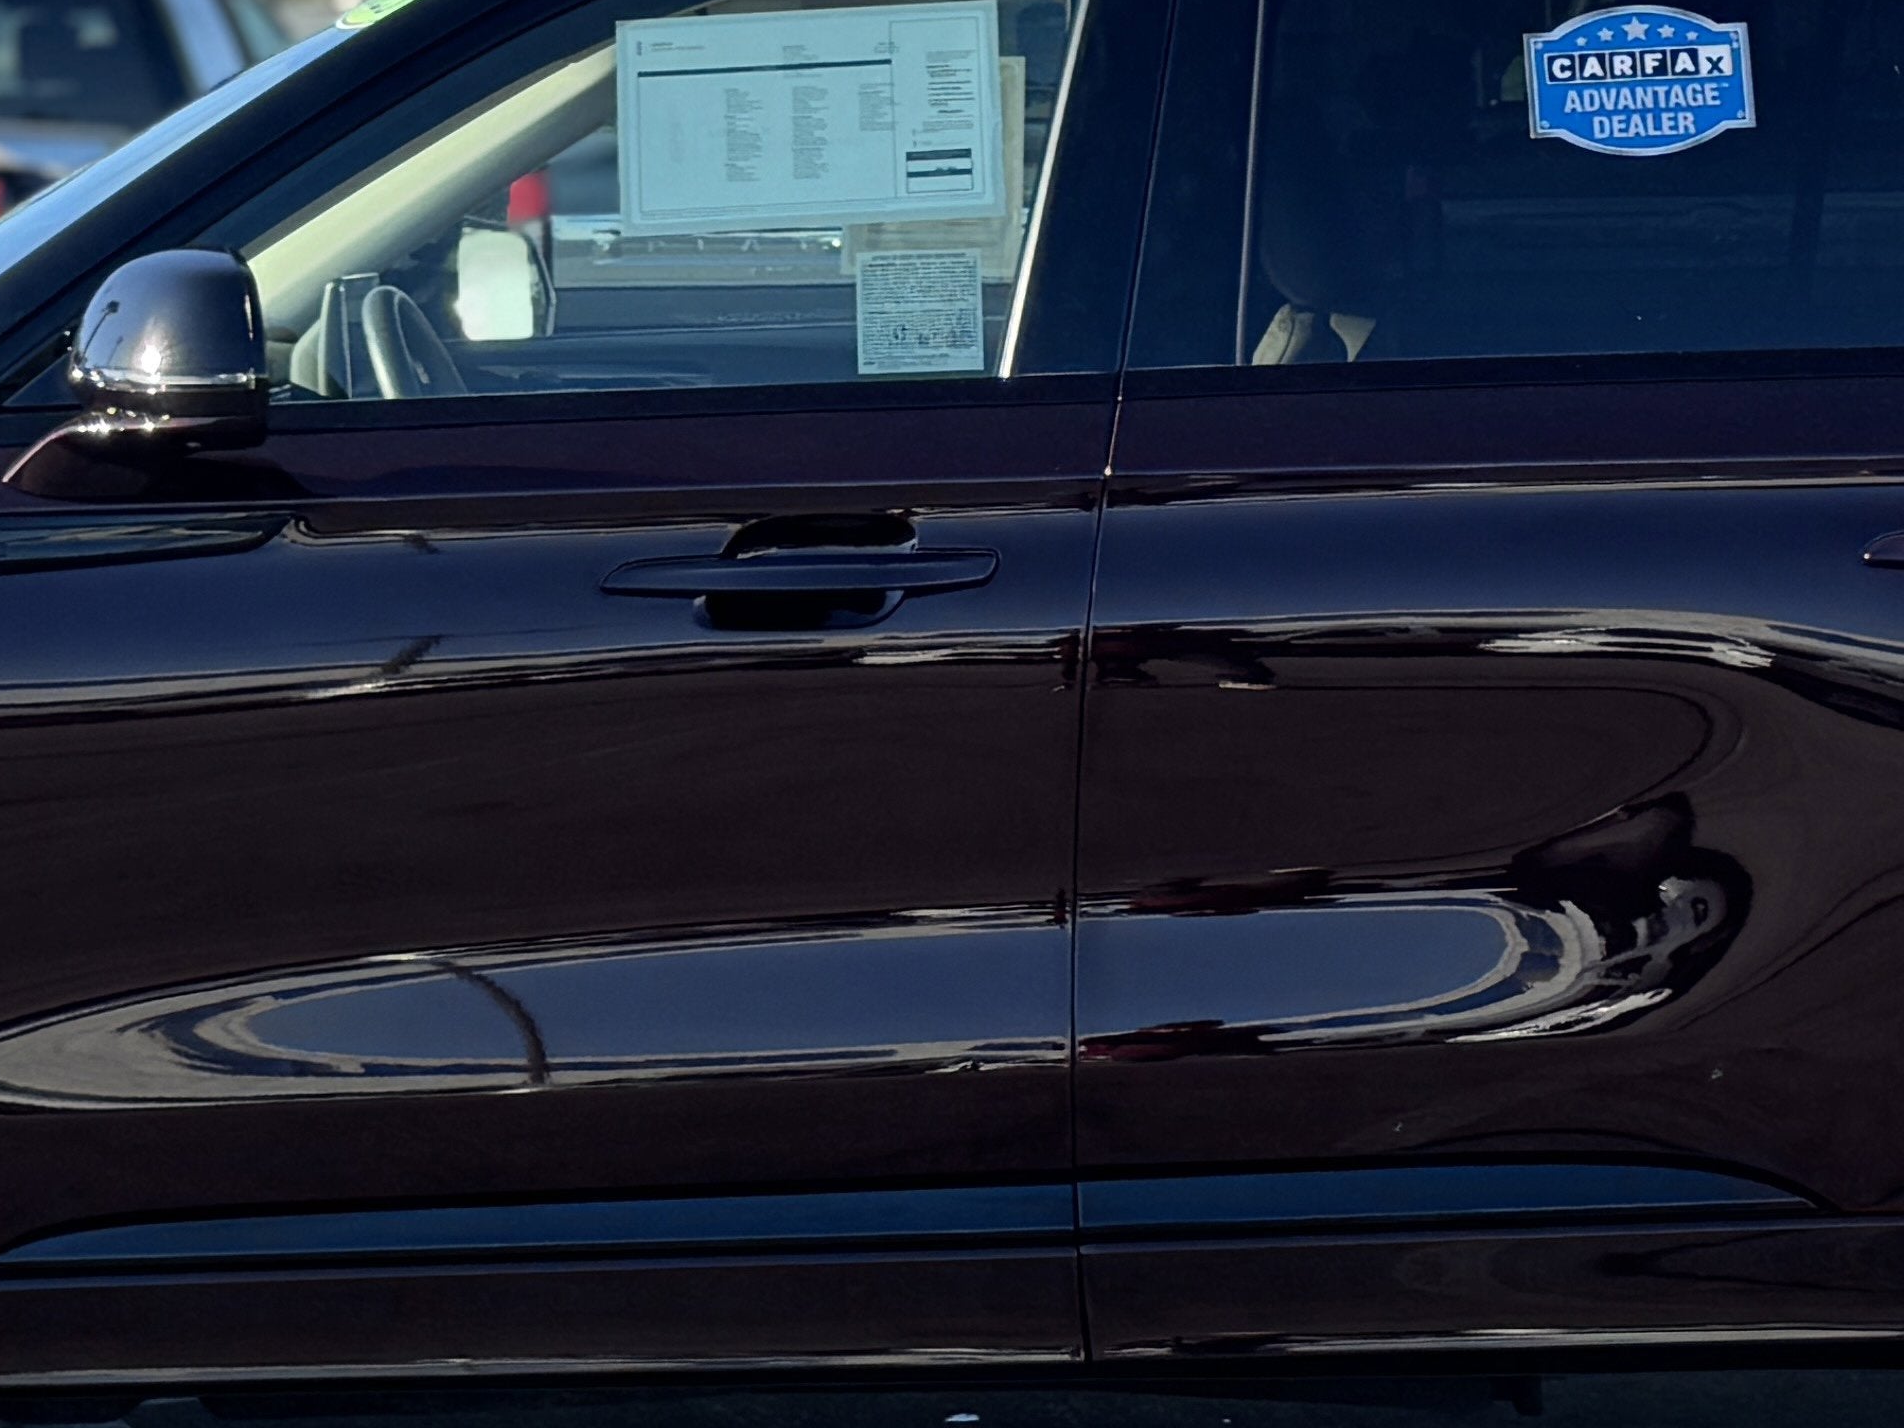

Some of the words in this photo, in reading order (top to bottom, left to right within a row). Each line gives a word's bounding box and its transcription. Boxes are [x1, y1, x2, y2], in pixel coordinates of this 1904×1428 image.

[1549, 49, 1728, 81] CARFAX
[1563, 82, 1722, 113] ADVANTAGE
[1592, 111, 1696, 140] DEALER
